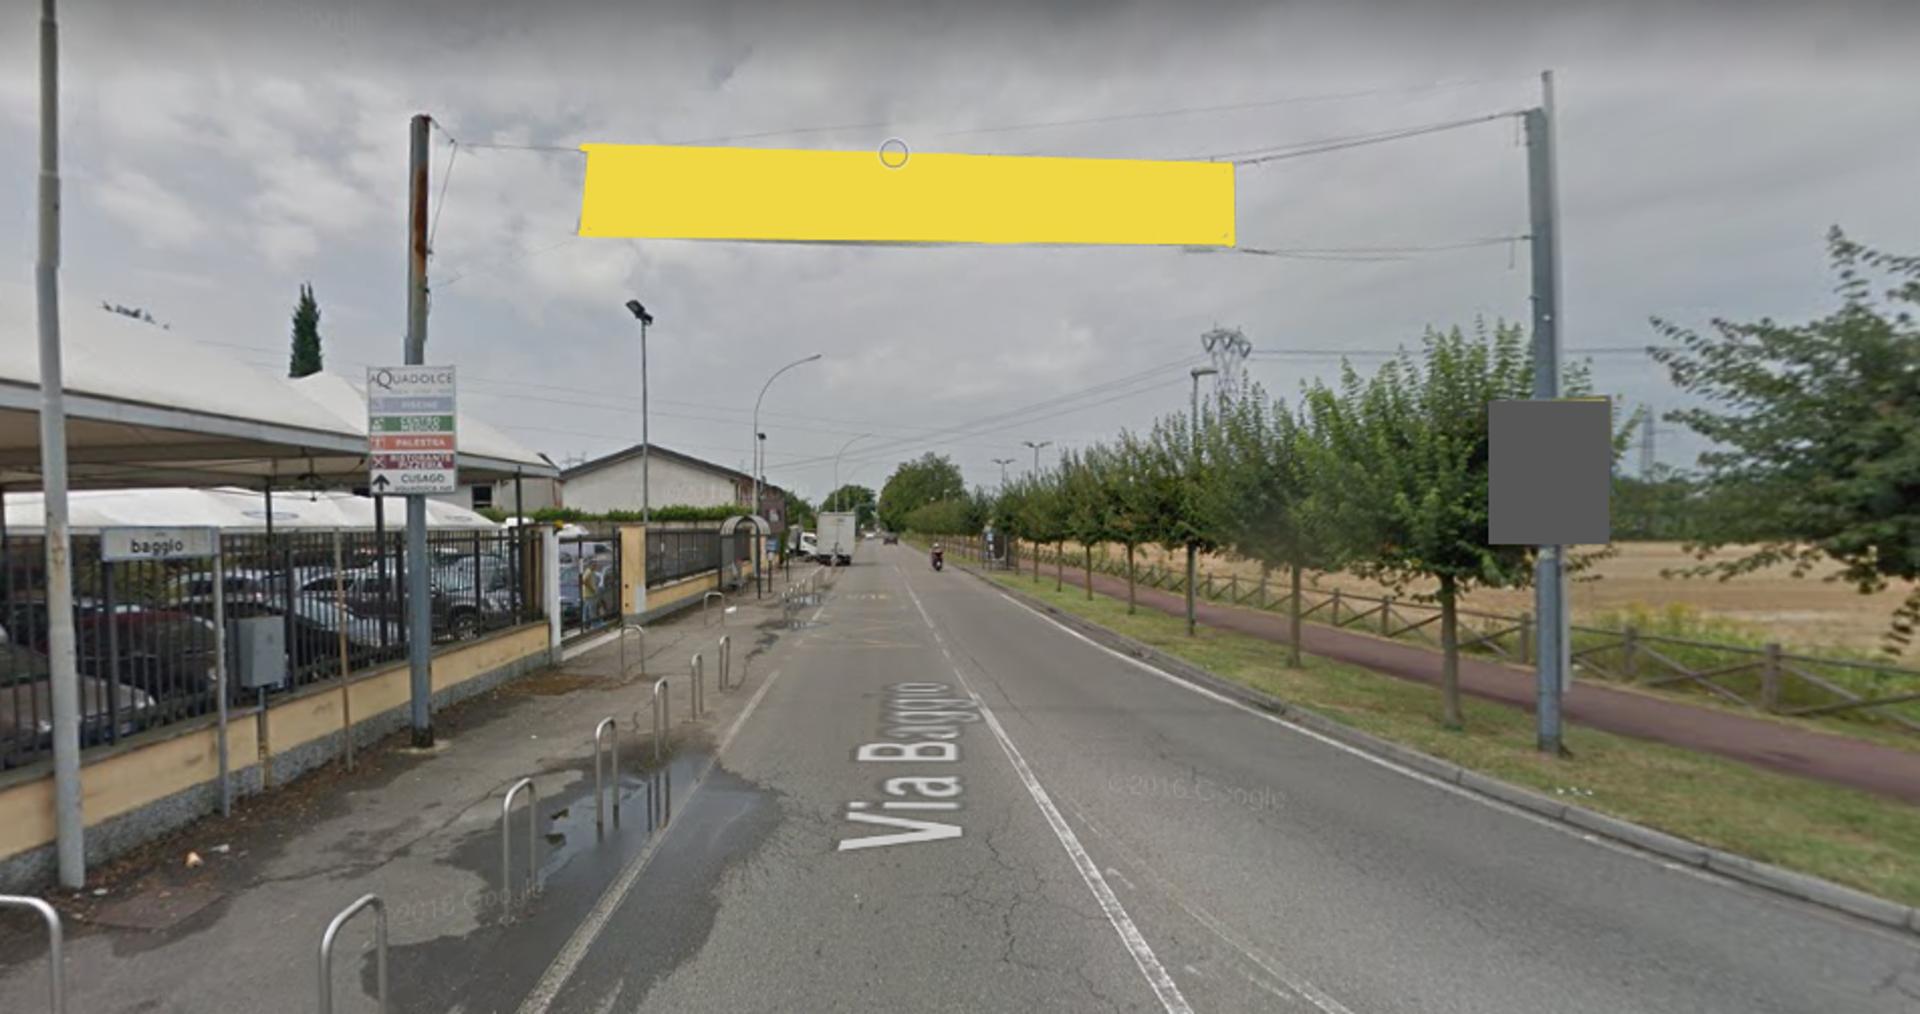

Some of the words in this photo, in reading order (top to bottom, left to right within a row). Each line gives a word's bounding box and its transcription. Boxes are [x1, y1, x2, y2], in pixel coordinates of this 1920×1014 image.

[368, 368, 453, 389] AQUADOLCE
[395, 438, 446, 448] PALESTRA
[398, 461, 445, 469] PIZZERIA
[401, 473, 445, 483] CUSAGO
[130, 539, 184, 556] baggio
